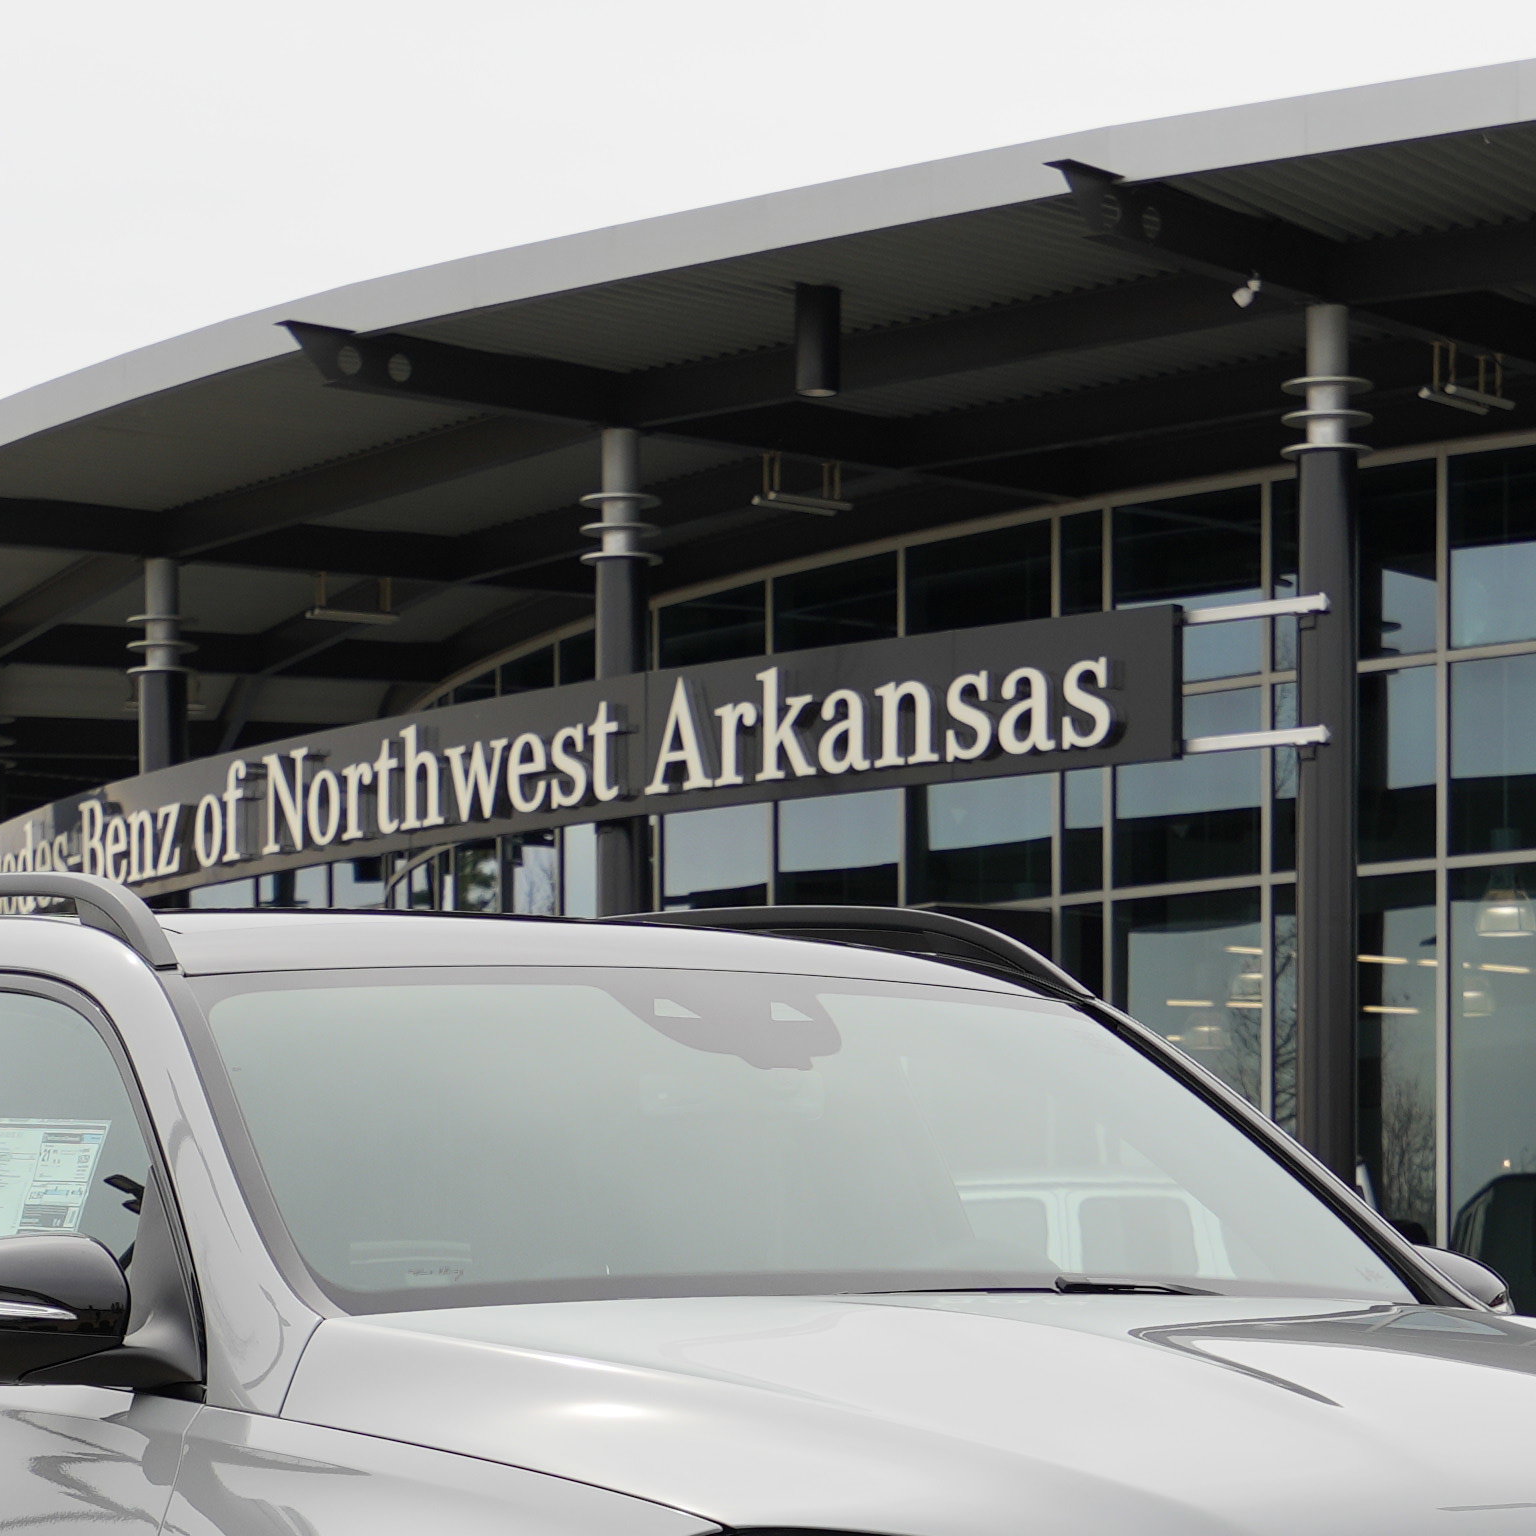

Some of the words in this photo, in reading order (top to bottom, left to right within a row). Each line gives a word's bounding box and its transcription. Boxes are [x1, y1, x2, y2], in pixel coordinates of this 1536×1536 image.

[195, 758, 247, 868] of
[261, 700, 620, 855] Northwest
[645, 655, 1114, 796] Arkansas
